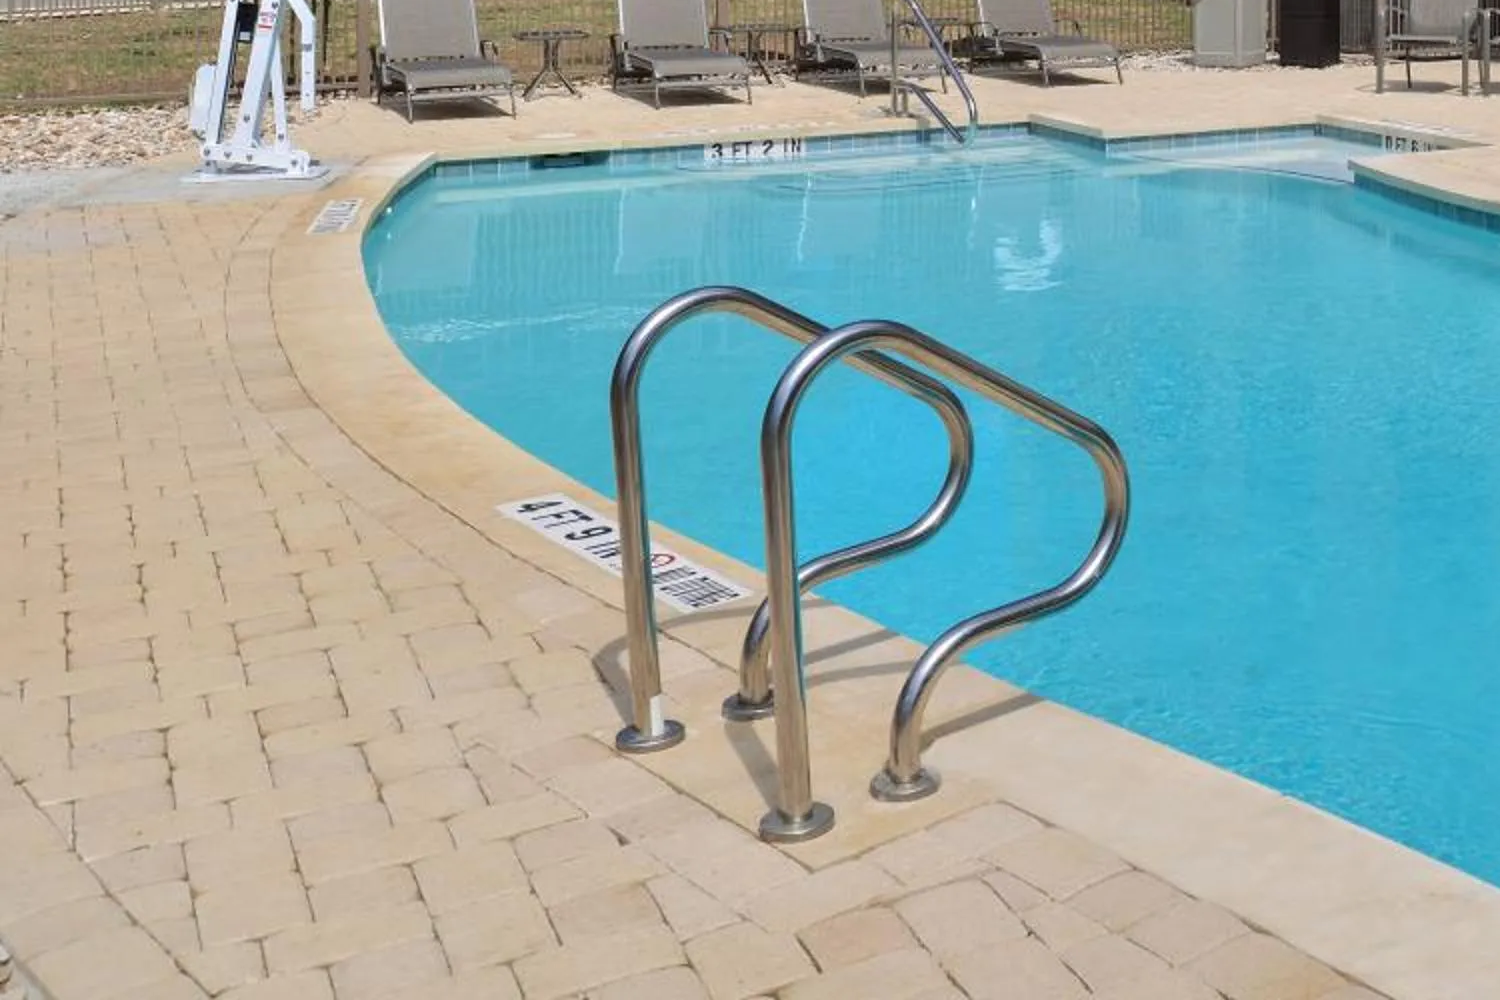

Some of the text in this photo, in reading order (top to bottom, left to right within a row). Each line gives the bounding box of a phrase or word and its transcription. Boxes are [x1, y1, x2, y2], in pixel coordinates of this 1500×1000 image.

[711, 137, 801, 158] 3 FT 2 IN
[517, 501, 563, 514] 4
[531, 509, 594, 529] FT
[564, 526, 613, 541] 9
